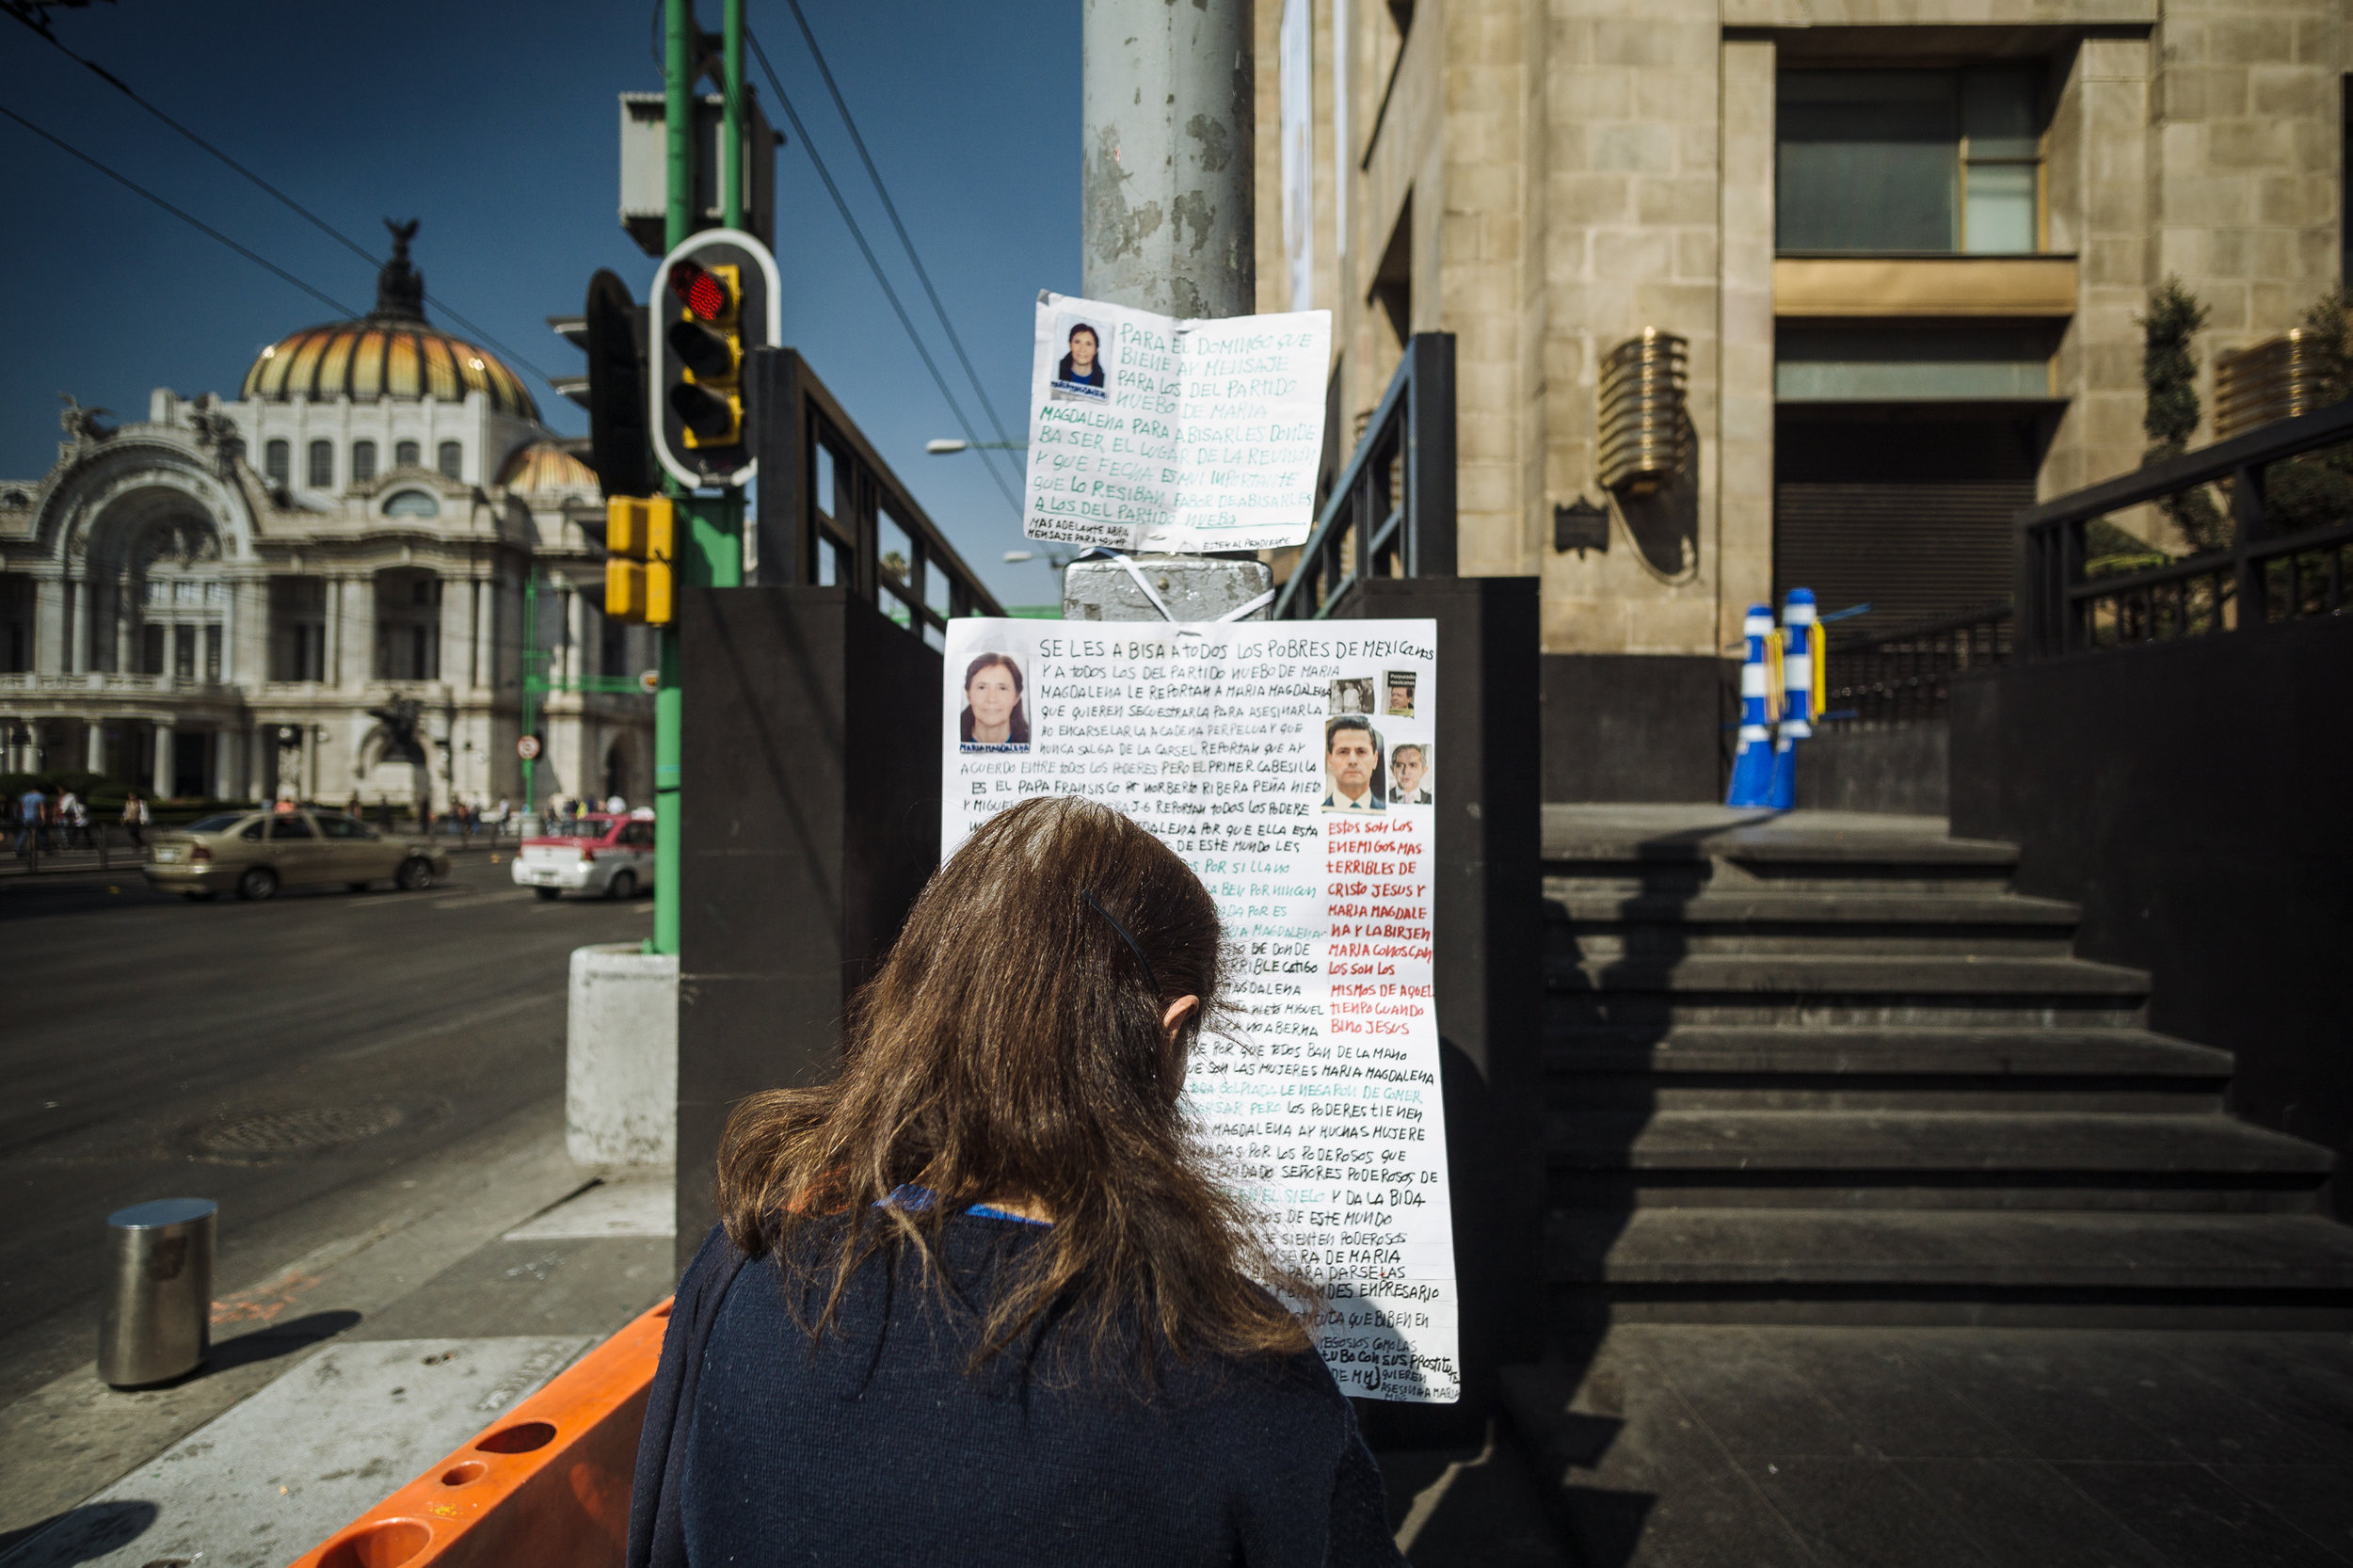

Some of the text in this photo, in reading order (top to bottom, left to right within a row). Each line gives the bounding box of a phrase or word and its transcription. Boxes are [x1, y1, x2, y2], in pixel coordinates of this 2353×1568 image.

[1120, 323, 1164, 353] PARA
[1172, 337, 1190, 354] EL
[1121, 346, 1172, 371] BIENE
[1117, 369, 1154, 392] PARA
[1190, 382, 1221, 398] DEL
[1182, 403, 1205, 419] DE
[1210, 402, 1268, 420] MARIA
[1040, 406, 1124, 430] MAGDALENA
[1132, 418, 1169, 439] PARA
[1039, 425, 1062, 443] BA
[1067, 431, 1105, 454] SER
[1112, 437, 1135, 453] EL
[1197, 447, 1219, 465] DE
[1224, 447, 1243, 463] LA
[1035, 450, 1048, 465] Y
[1160, 468, 1177, 483] ES
[1034, 496, 1045, 509] A
[1080, 501, 1112, 518] DEL
[1030, 518, 1053, 529] MAS
[1039, 639, 1063, 658] SE
[1070, 640, 1105, 658] LES
[1337, 641, 1358, 659] DE
[1143, 664, 1167, 679] DEL
[1279, 664, 1296, 679] DE
[1301, 664, 1340, 678] MARIA
[1041, 684, 1122, 699] MAGDALENA
[1128, 686, 1144, 699] LE
[1214, 685, 1222, 697] A
[1225, 683, 1265, 697] MARIA
[1041, 705, 1066, 719] QUE
[1213, 705, 1243, 717] PARA
[1119, 743, 1135, 755] DE
[1138, 744, 1150, 755] LA
[1209, 760, 1254, 773] PRIMER
[971, 781, 986, 794] ES
[996, 780, 1012, 792] EL
[1018, 780, 1050, 794] PAPA
[1202, 780, 1248, 795] RIBERA
[1225, 824, 1252, 838] QUE
[1257, 822, 1287, 836] ELLA
[1176, 840, 1193, 852] DE
[1275, 840, 1300, 854] LES
[1397, 842, 1422, 856] MAS
[1399, 861, 1417, 875] DE
[1371, 883, 1426, 898] JESUS Y
[1328, 903, 1427, 920] MARIA MAGDALE
[1354, 924, 1363, 937] Y
[1328, 942, 1370, 957] MARIA
[1379, 984, 1397, 998] DE
[1365, 1019, 1410, 1034] JESUS
[1337, 1045, 1353, 1059] DE
[1356, 1048, 1370, 1059] LA
[1234, 1062, 1434, 1086] LAS MUJERES MARIA MAGDALENA
[1363, 1084, 1381, 1099] DE
[1298, 1125, 1316, 1137] AY
[1381, 1149, 1406, 1164] QUE
[1420, 1171, 1438, 1184] DE
[1333, 1189, 1426, 1208] Y DA LA BIDA
[1287, 1209, 1305, 1224] DE
[1325, 1248, 1401, 1265] DE MARIA
[1415, 1312, 1429, 1328] EN
[1382, 1353, 1408, 1367] SUS
